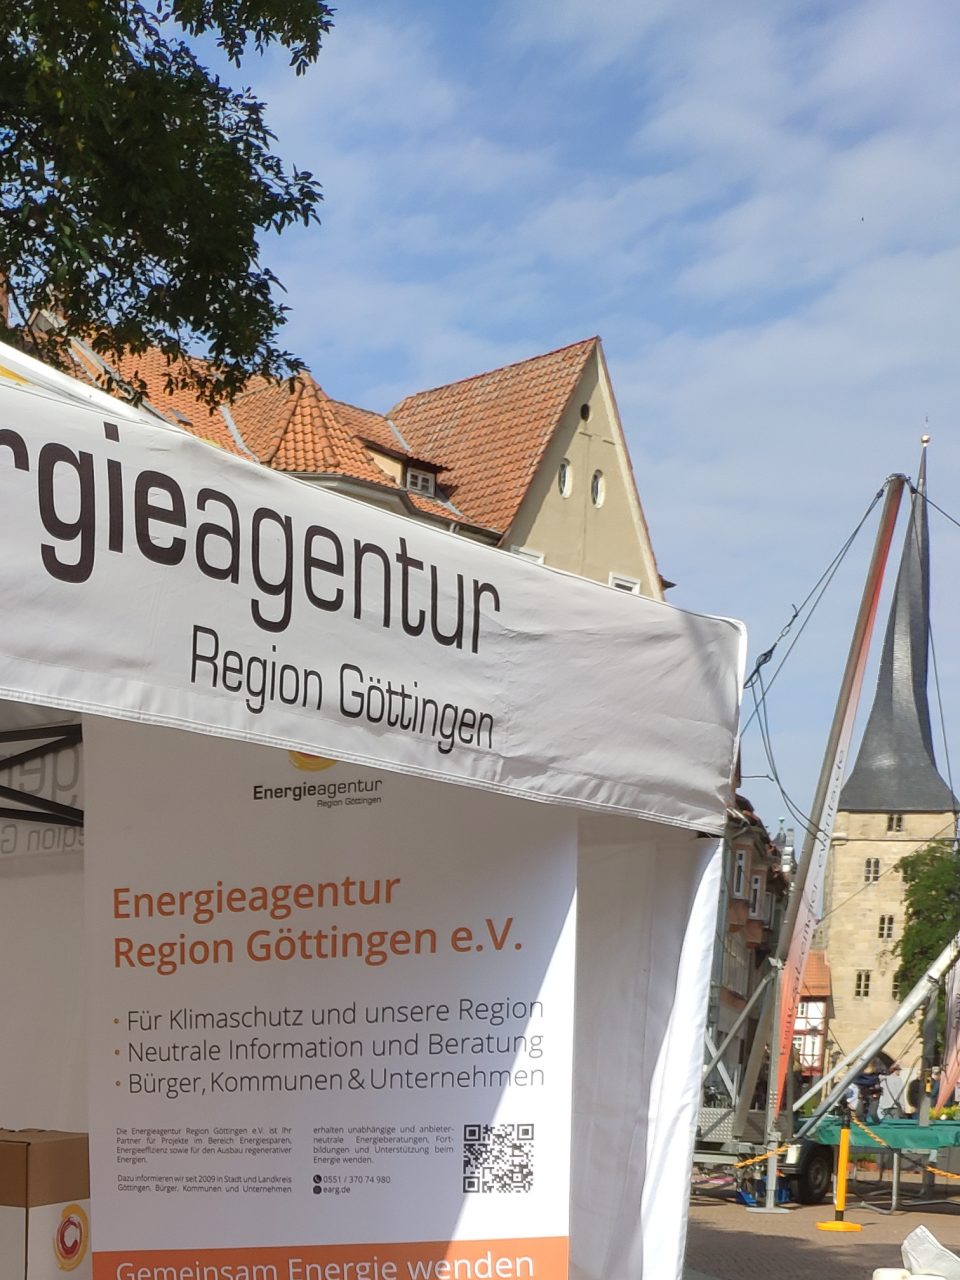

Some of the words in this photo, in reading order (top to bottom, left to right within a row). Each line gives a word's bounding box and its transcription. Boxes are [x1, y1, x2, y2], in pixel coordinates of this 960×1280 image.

[192, 624, 322, 714] Region
[338, 663, 495, 755] Göttingen
[253, 779, 383, 801] Energieagentur
[317, 800, 343, 808] Region
[345, 796, 382, 806] Göttingen
[113, 876, 401, 924] Energieagentur
[113, 933, 234, 976] Region
[246, 925, 438, 967] Göttingen
[449, 917, 523, 953] e.V.
[128, 1008, 162, 1031] Für
[169, 1005, 304, 1030] Klimaschutz
[311, 1002, 356, 1026] und
[365, 1003, 450, 1024] unsere
[458, 997, 544, 1026] Region
[128, 1040, 221, 1063] Neutrale
[229, 1035, 363, 1061] Information
[372, 1033, 418, 1057] und
[428, 1033, 544, 1059] Beratung
[128, 1072, 207, 1099] Bürger,
[210, 1070, 342, 1093] Kommunen
[347, 1068, 366, 1090] &
[370, 1065, 545, 1090] Unternehmen
[132, 1128, 181, 1136] Energieagentur
[186, 1128, 209, 1136] Region
[214, 1128, 247, 1136] Göttingen
[348, 1126, 396, 1135] unabhängige
[245, 1147, 292, 1155] regenerativer
[314, 1156, 341, 1165] Energie
[375, 1146, 429, 1154] Unterstützung
